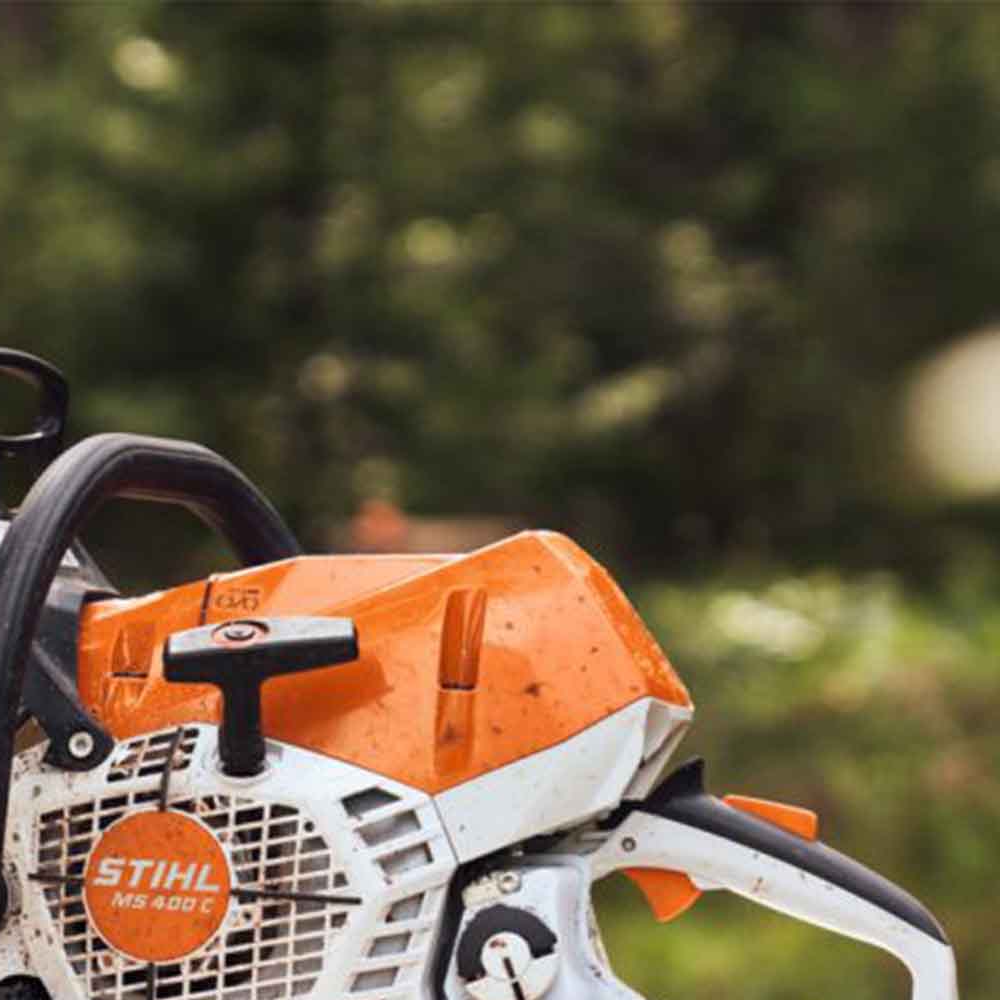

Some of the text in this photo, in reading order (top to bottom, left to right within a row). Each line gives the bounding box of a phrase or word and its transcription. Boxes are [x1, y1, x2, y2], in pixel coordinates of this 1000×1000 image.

[94, 858, 220, 892] STIHL
[111, 892, 148, 910] MS
[151, 896, 197, 913] 400
